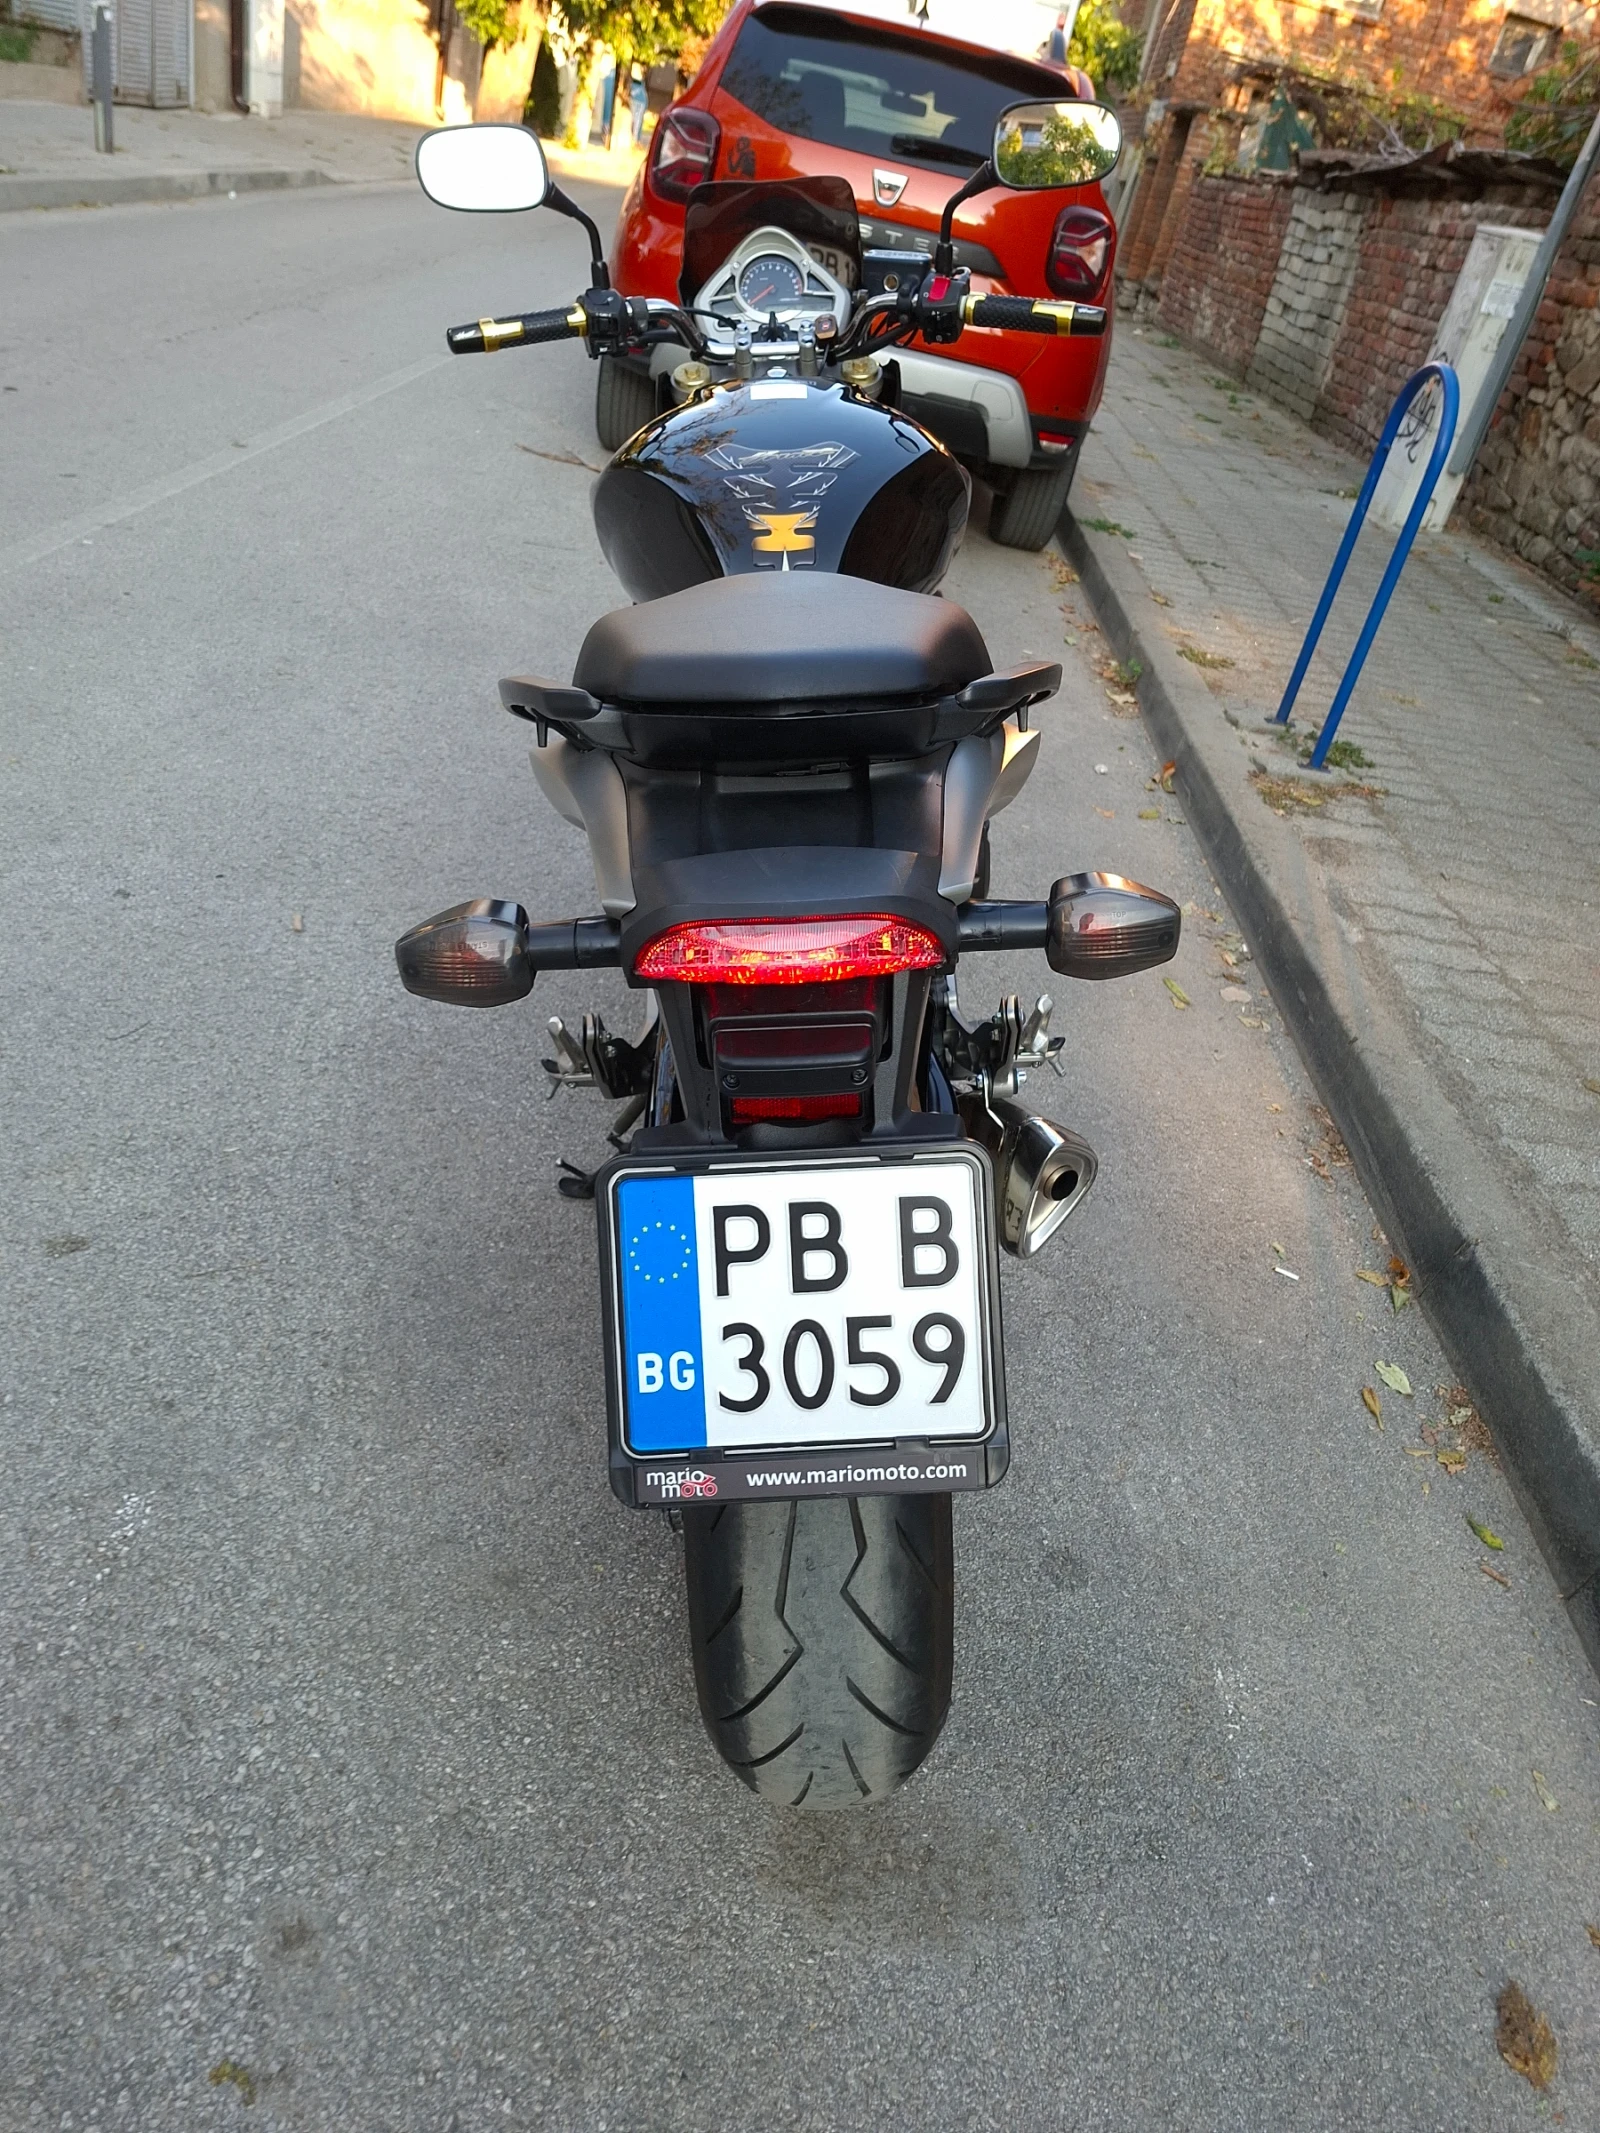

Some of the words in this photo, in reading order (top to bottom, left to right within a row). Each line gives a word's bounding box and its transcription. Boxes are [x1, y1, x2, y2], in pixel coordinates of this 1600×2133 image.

[711, 1200, 849, 1297] PB
[897, 1194, 961, 1288] B
[636, 1350, 696, 1394] BG
[717, 1311, 966, 1413] 3059
[646, 1467, 706, 1486] mario
[661, 1482, 718, 1499] moto
[746, 1462, 968, 1487] www.mariomoto.com
